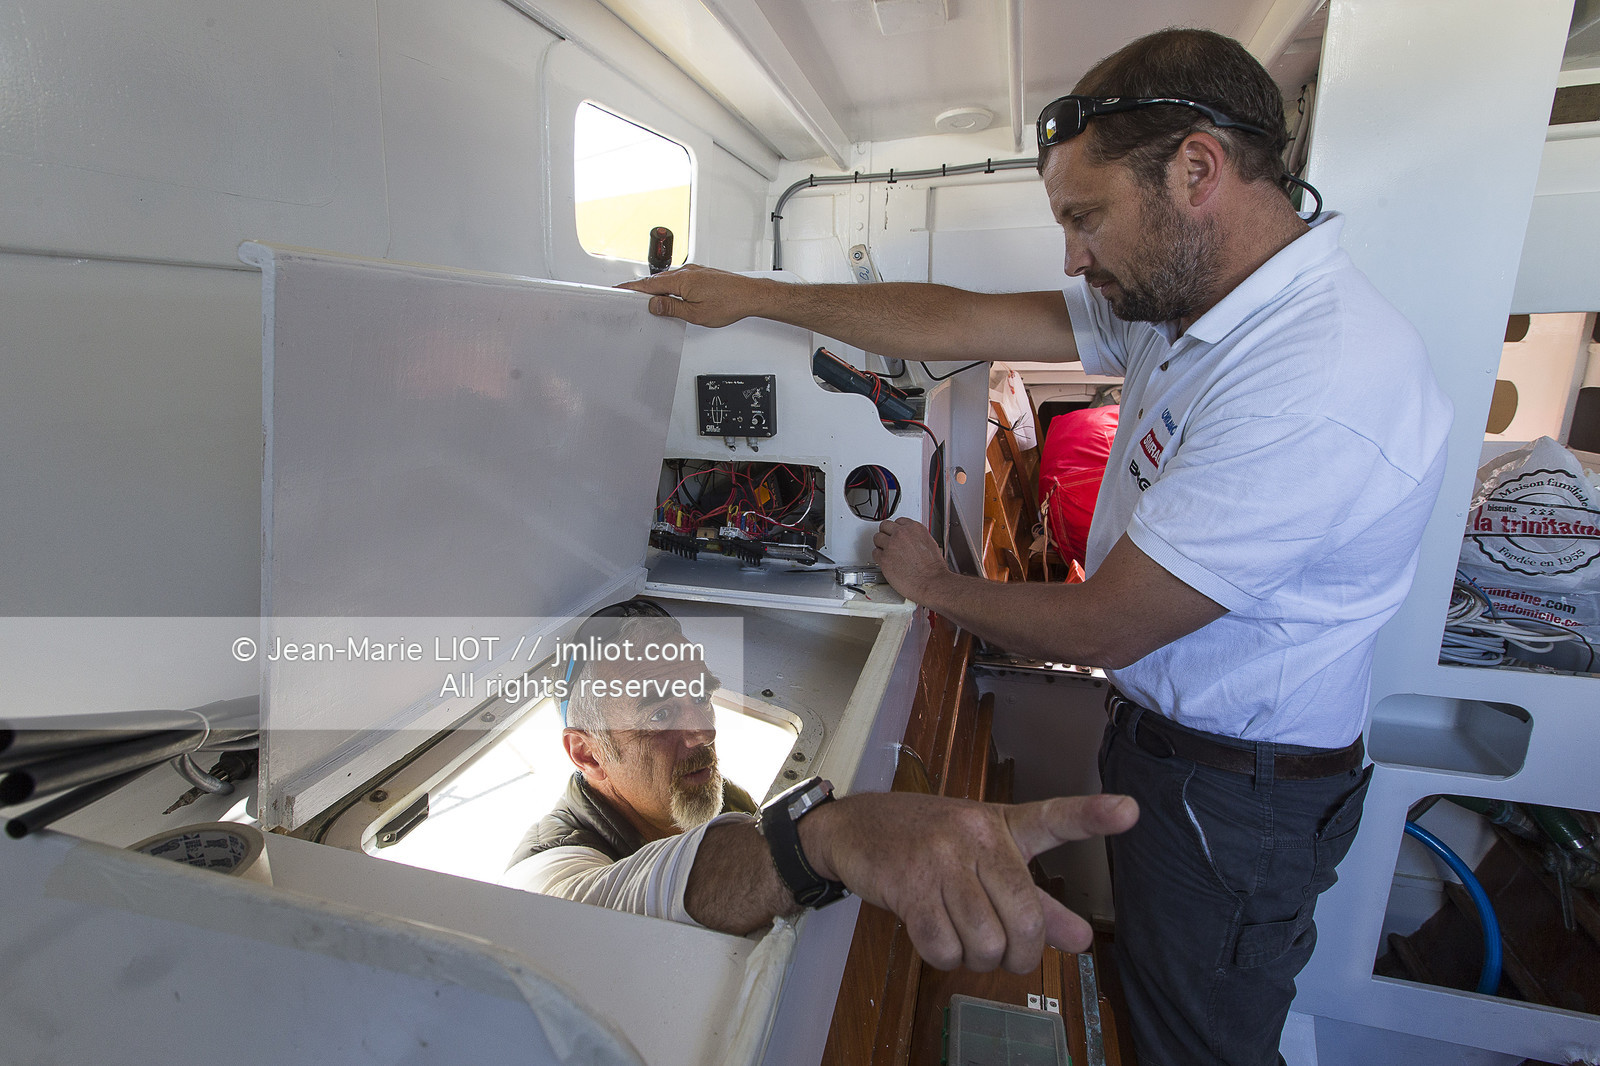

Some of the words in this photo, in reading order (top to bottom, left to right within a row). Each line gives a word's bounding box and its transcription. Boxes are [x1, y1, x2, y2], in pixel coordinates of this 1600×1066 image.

[1498, 480, 1545, 499] Maison
[1547, 477, 1589, 507] familiale
[1473, 504, 1493, 532] la
[1486, 503, 1518, 513] biscuits
[1498, 546, 1536, 567] Fondée
[1557, 548, 1586, 566] 1955
